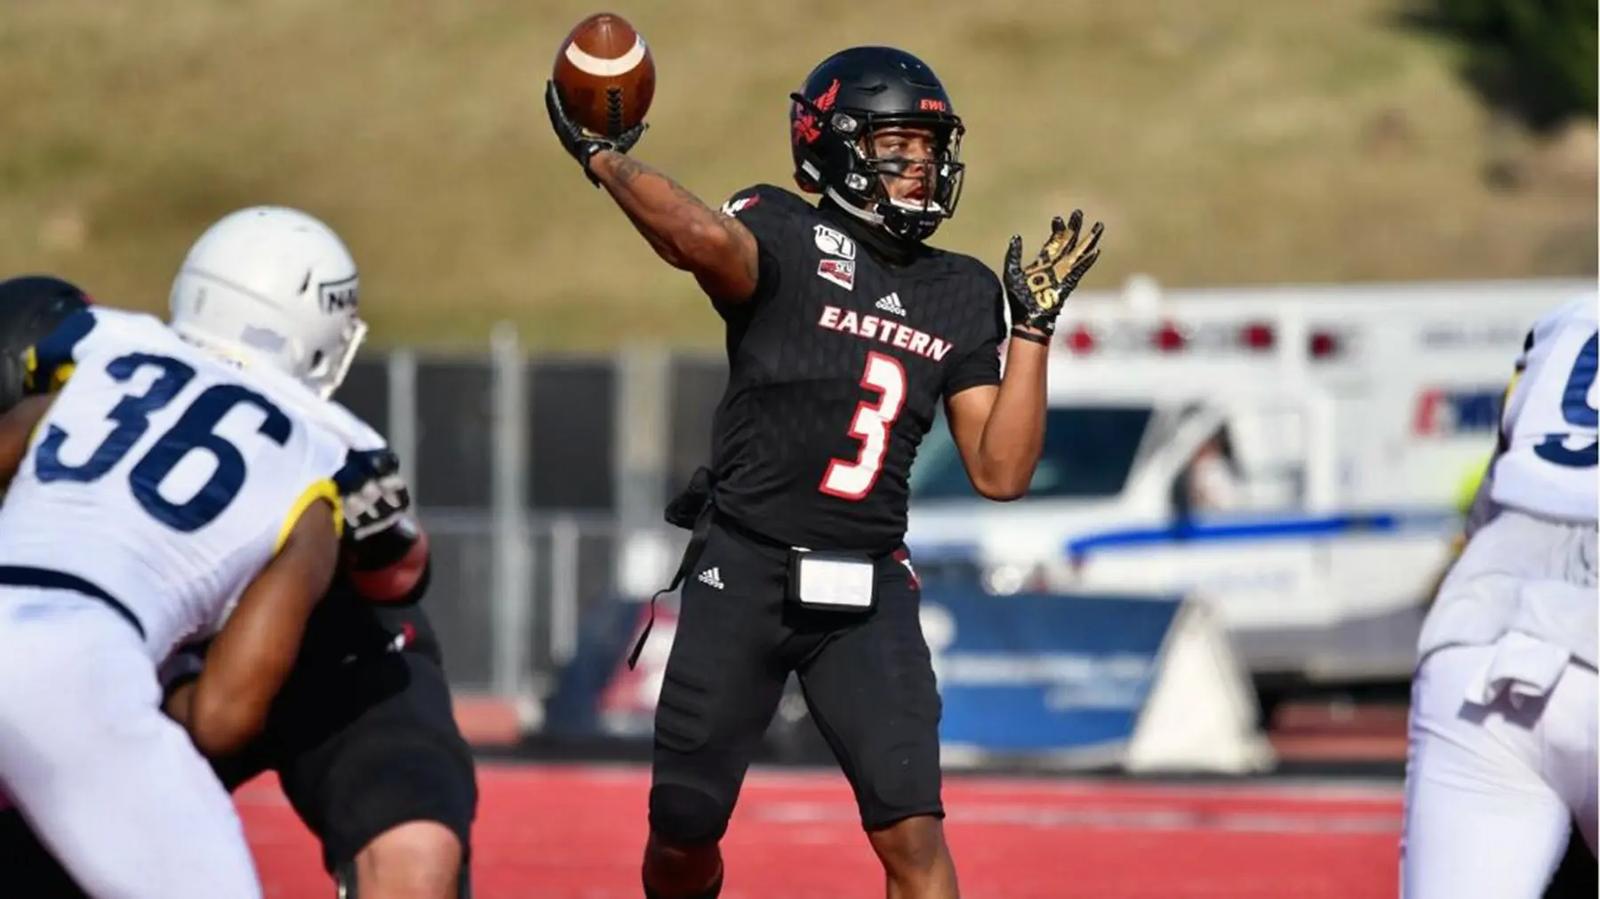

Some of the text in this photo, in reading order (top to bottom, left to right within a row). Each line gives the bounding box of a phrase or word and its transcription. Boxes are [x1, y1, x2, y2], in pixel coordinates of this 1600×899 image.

[328, 288, 358, 314] NA
[818, 304, 953, 362] EASTERN
[34, 351, 293, 533] 36
[818, 350, 908, 500] 3
